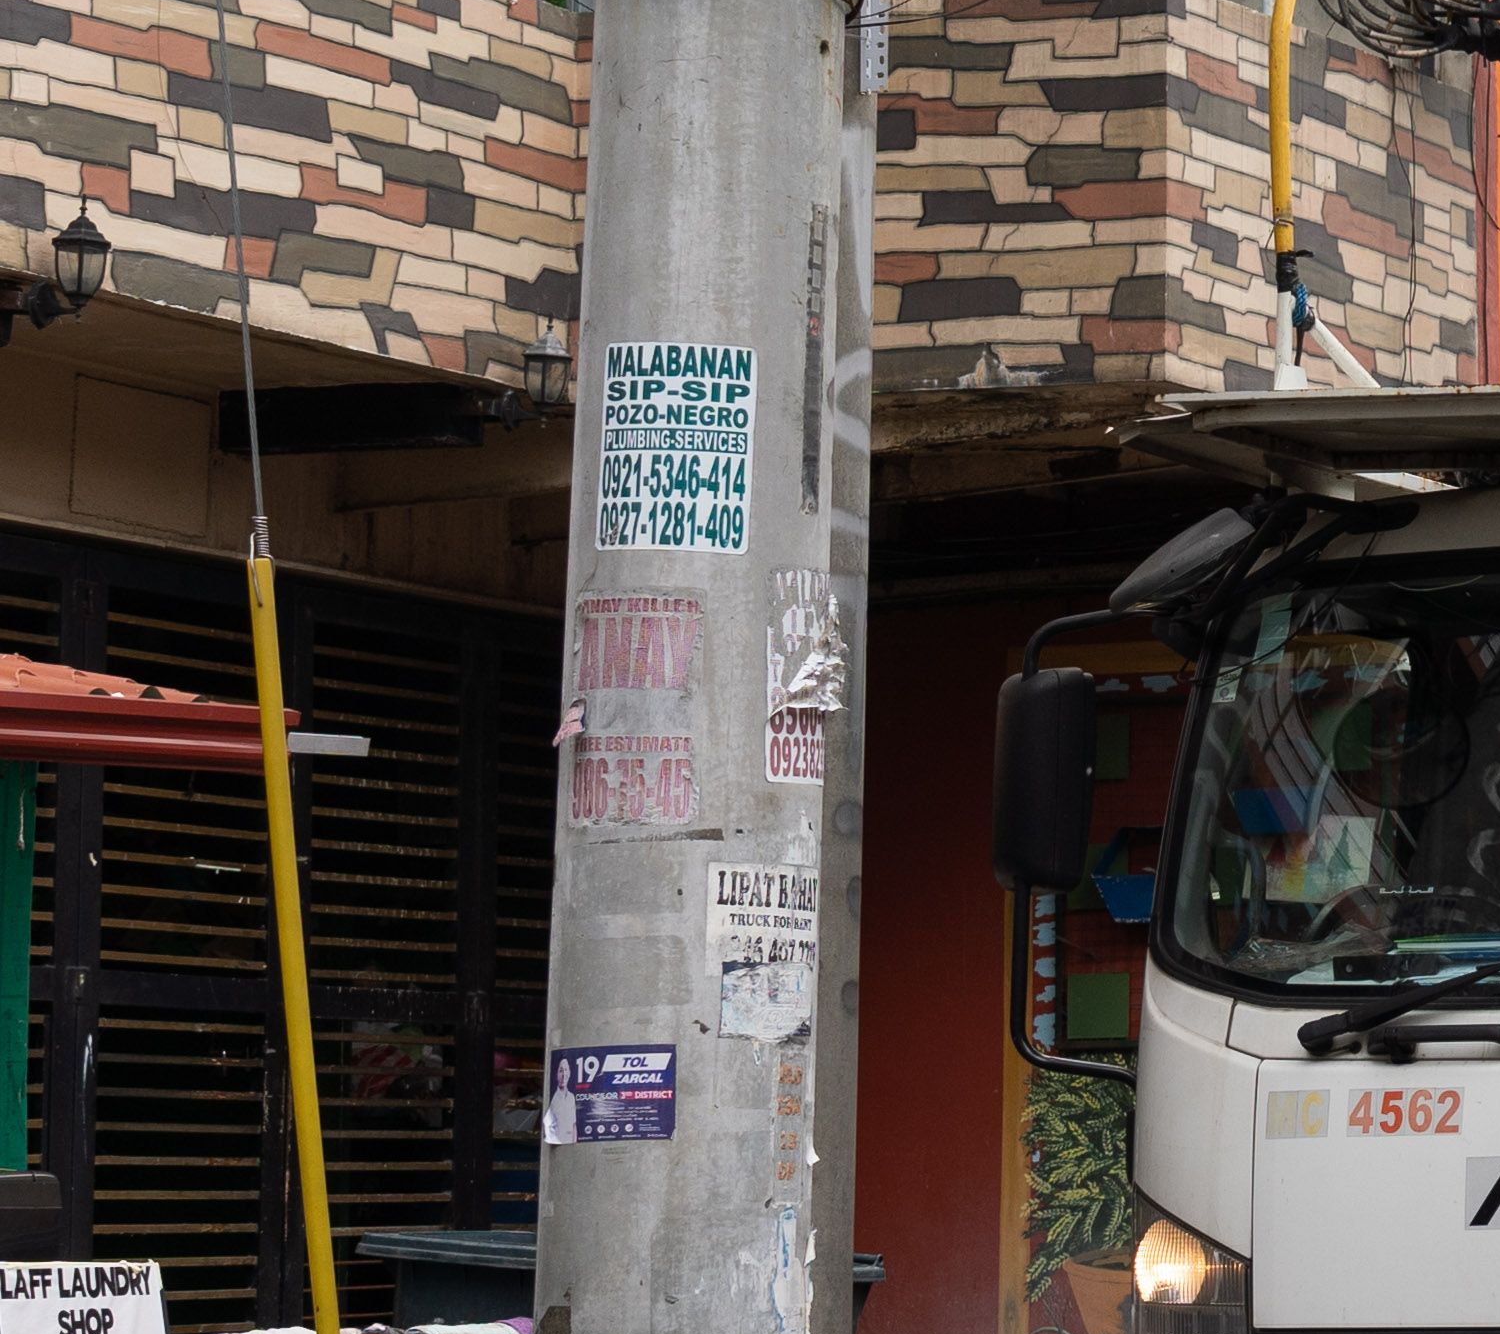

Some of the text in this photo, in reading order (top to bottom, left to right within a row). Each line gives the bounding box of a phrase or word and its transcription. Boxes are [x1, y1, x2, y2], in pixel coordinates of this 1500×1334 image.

[607, 345, 752, 381] MALABANAN
[607, 380, 750, 404] SIP-SIP
[605, 404, 749, 429] POZO-NEGRO
[605, 430, 747, 454] PLUMBING-SERVICES
[601, 453, 746, 500] 0921-5346-414
[599, 500, 744, 549] 0927-1281-409
[578, 617, 698, 691] ANAY
[717, 870, 775, 908] LIPAT
[729, 913, 771, 928] TRUCK
[575, 1056, 648, 1084] 19 TOL
[611, 1073, 663, 1085] ZARCAL
[634, 1090, 673, 1100] DISTRICT
[1348, 1090, 1462, 1135] 4562
[1, 1265, 152, 1300] LAFF LAUNDRY
